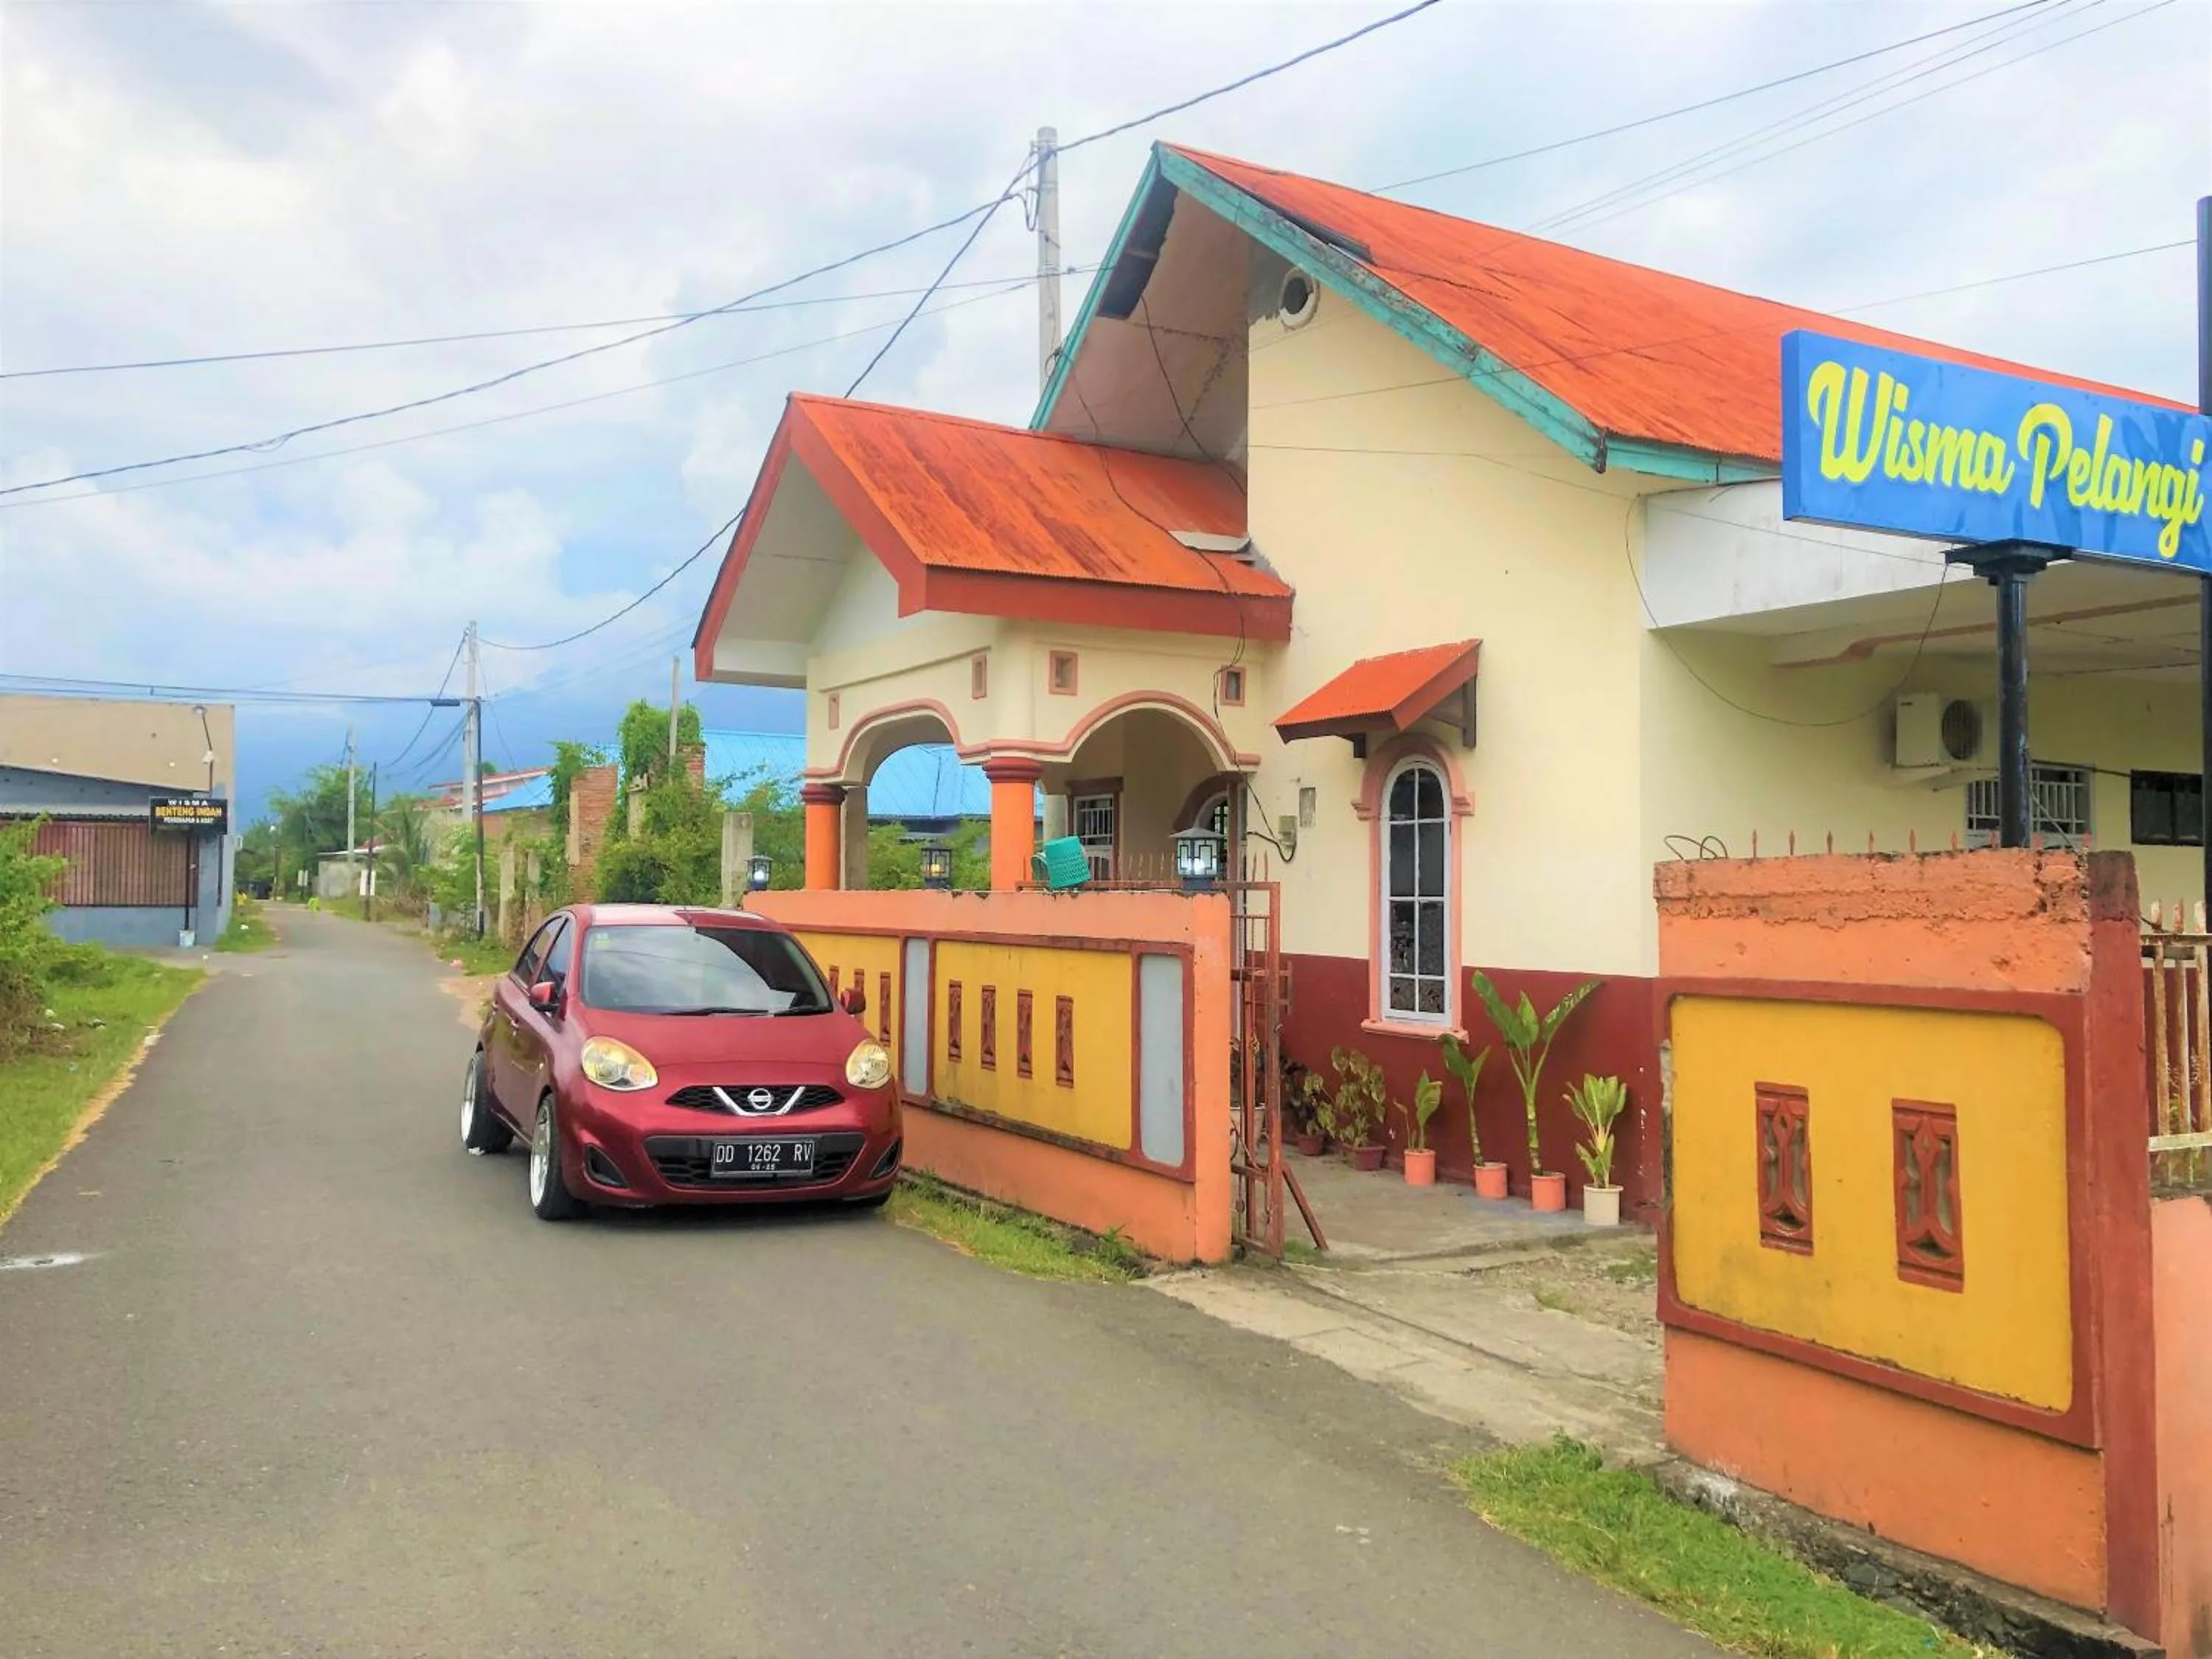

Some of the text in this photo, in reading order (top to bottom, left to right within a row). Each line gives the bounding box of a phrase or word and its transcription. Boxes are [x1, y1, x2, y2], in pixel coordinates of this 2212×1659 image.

[1807, 361, 2204, 558] Wisma Pelangi
[716, 1144, 812, 1163] DD 1262 RV
